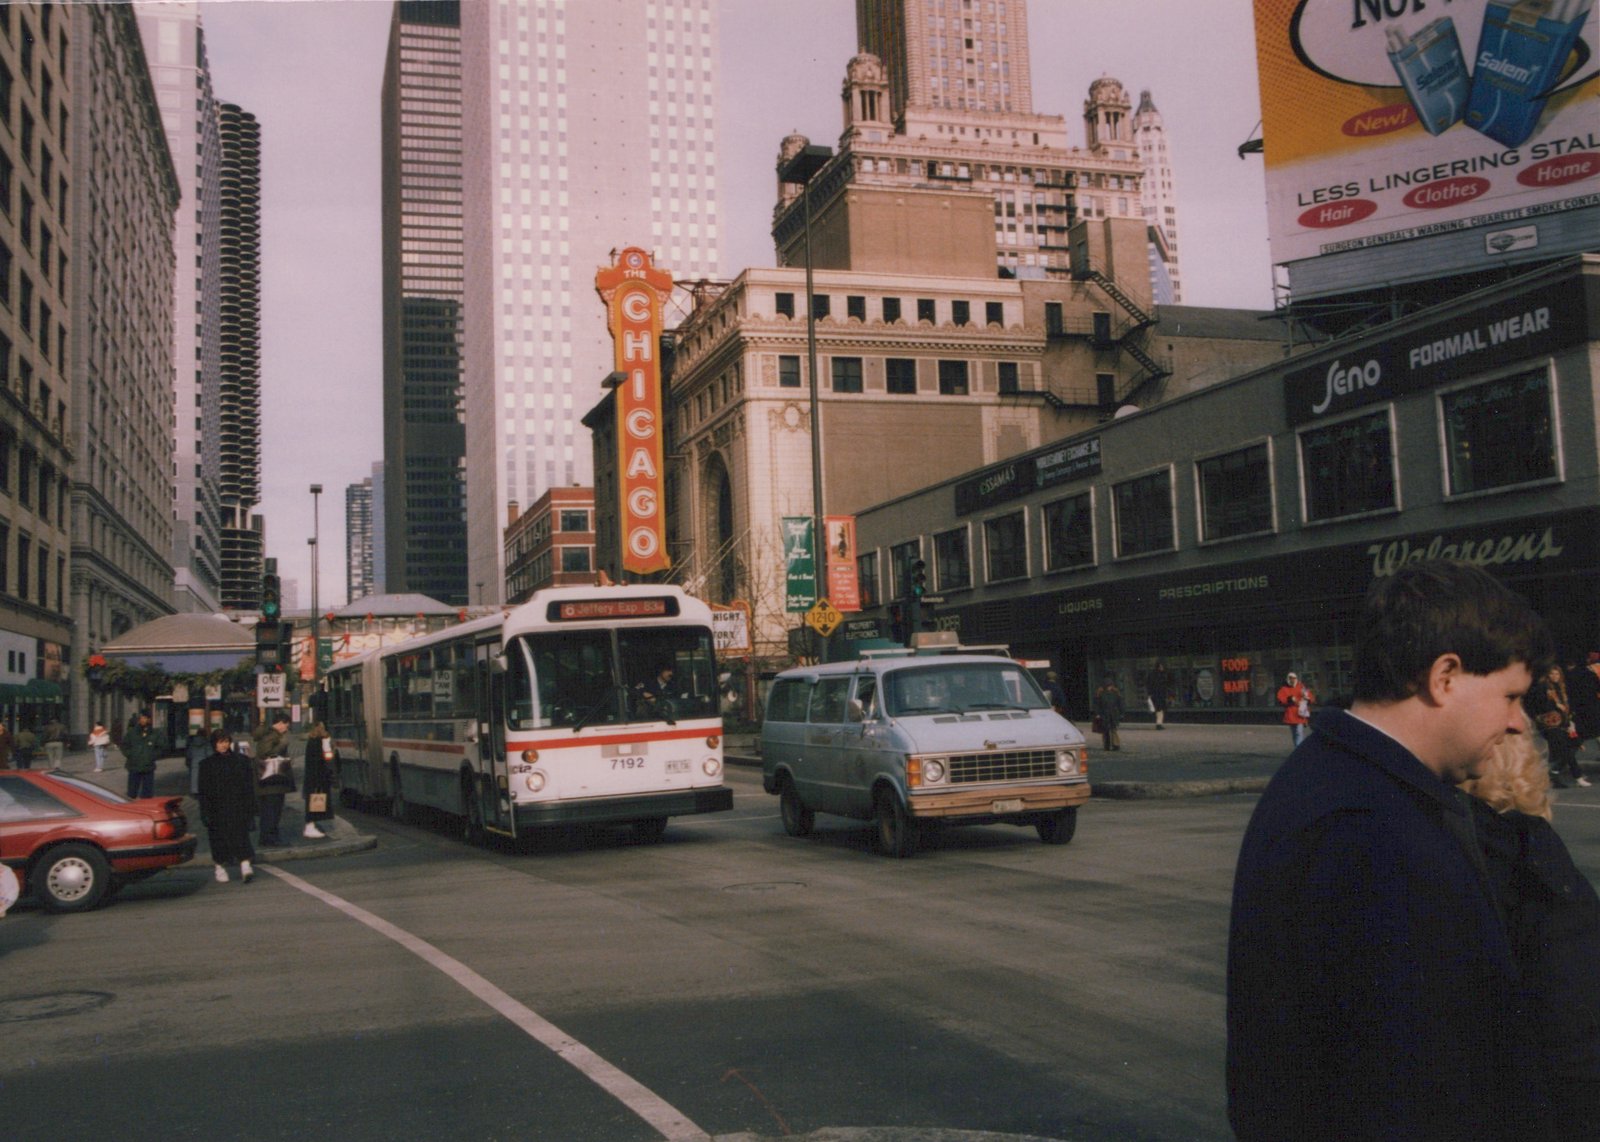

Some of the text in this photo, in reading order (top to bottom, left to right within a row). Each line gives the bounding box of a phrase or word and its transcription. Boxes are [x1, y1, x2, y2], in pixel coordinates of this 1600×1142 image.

[1476, 51, 1529, 83] Salem
[1354, 109, 1408, 133] New!
[1297, 182, 1360, 206] LESS
[1369, 149, 1520, 193] LINGERING
[1537, 160, 1592, 182] Home
[1414, 182, 1478, 205] Clothes
[1319, 204, 1354, 223] Hair
[1323, 239, 1364, 254] SURGEON
[1366, 231, 1415, 246] GENERAL'S
[1471, 207, 1523, 226] CIGARETTE
[1525, 201, 1562, 216] SMOKE
[623, 270, 647, 279] THE
[1409, 307, 1550, 370] FORMAL WEAR
[621, 291, 659, 559] CHICAGO
[1159, 575, 1269, 600] PRESCRIPTIONS
[577, 602, 614, 615] Jeffery
[618, 602, 638, 613] Exp
[1058, 599, 1103, 614] LIQUORS
[1221, 657, 1249, 671] FOOD
[262, 676, 281, 685] ONE
[262, 686, 281, 694] WAY
[1222, 679, 1250, 694] MART
[610, 757, 645, 770] 7192
